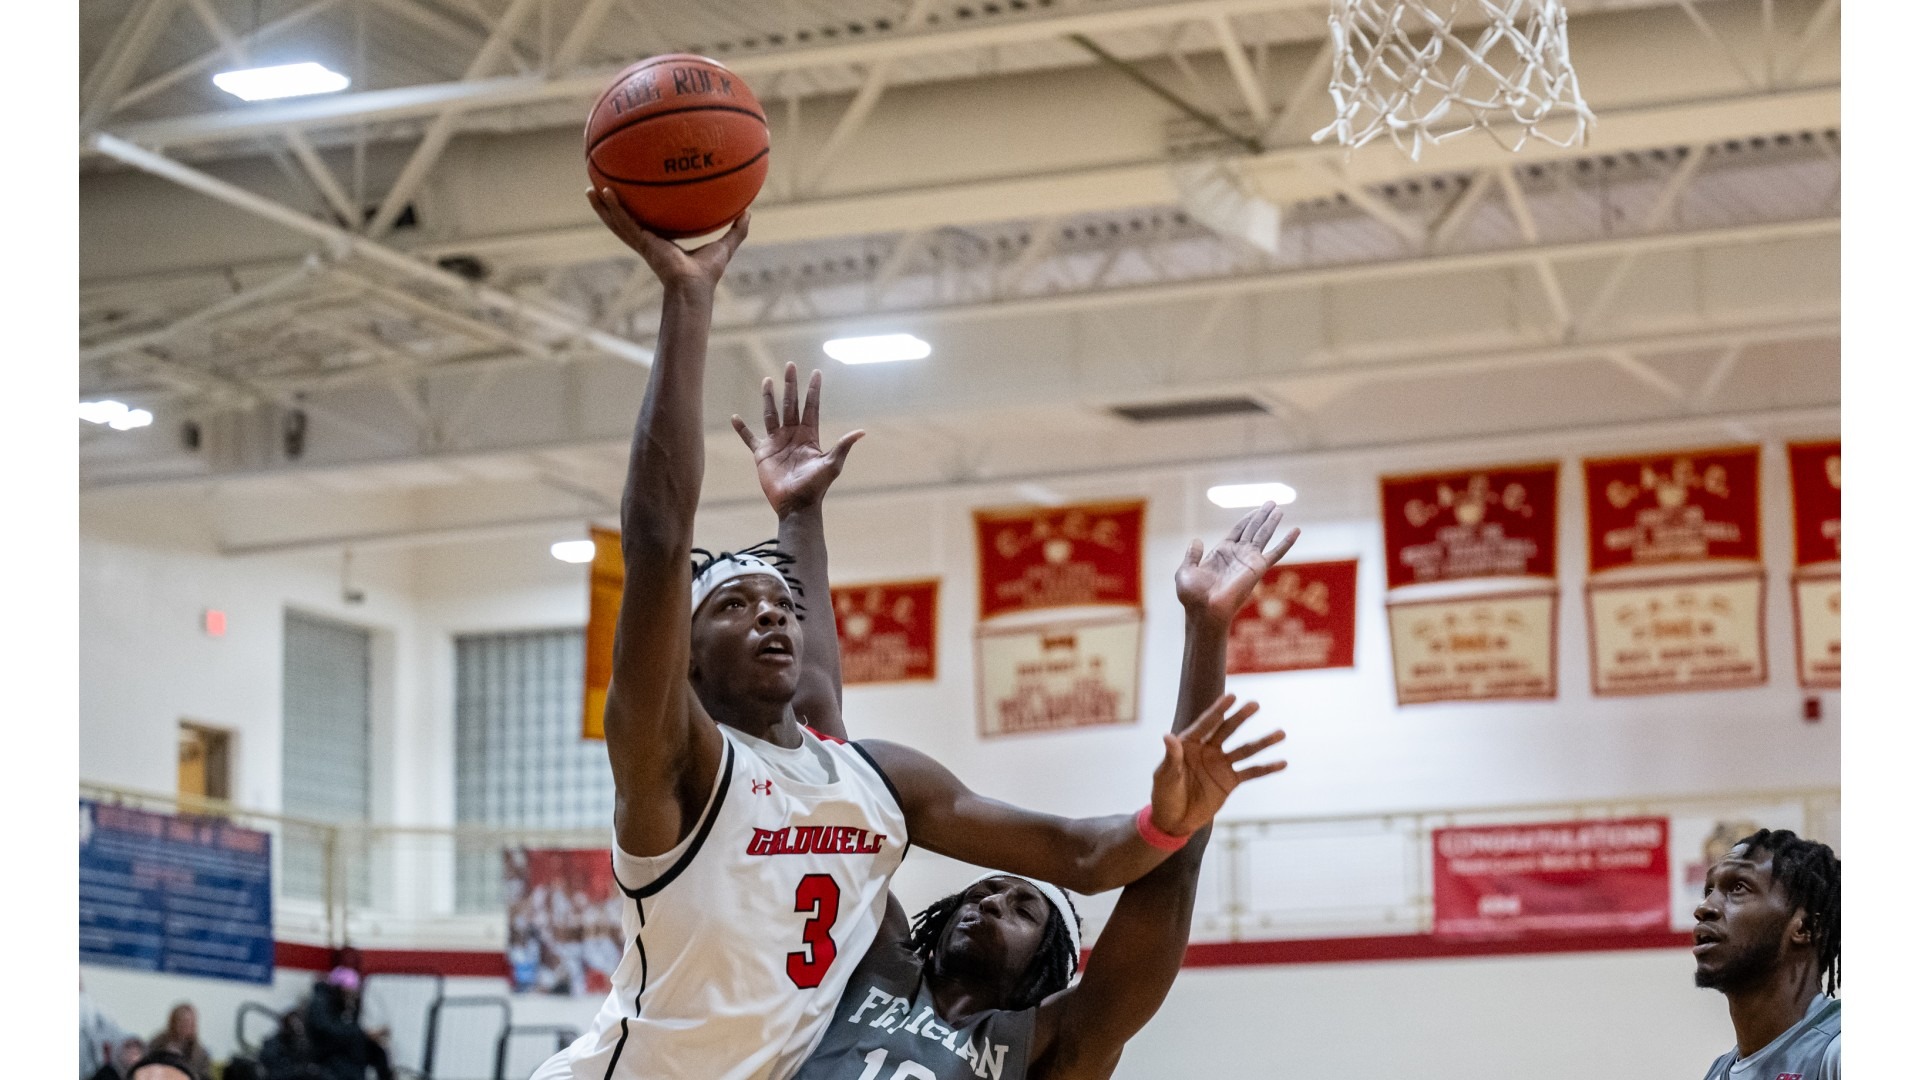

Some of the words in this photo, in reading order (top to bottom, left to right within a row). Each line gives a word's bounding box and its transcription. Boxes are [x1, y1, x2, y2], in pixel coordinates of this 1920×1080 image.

[664, 152, 714, 173] ROCK
[746, 826, 887, 855] CALDWELL
[786, 874, 840, 989] 3
